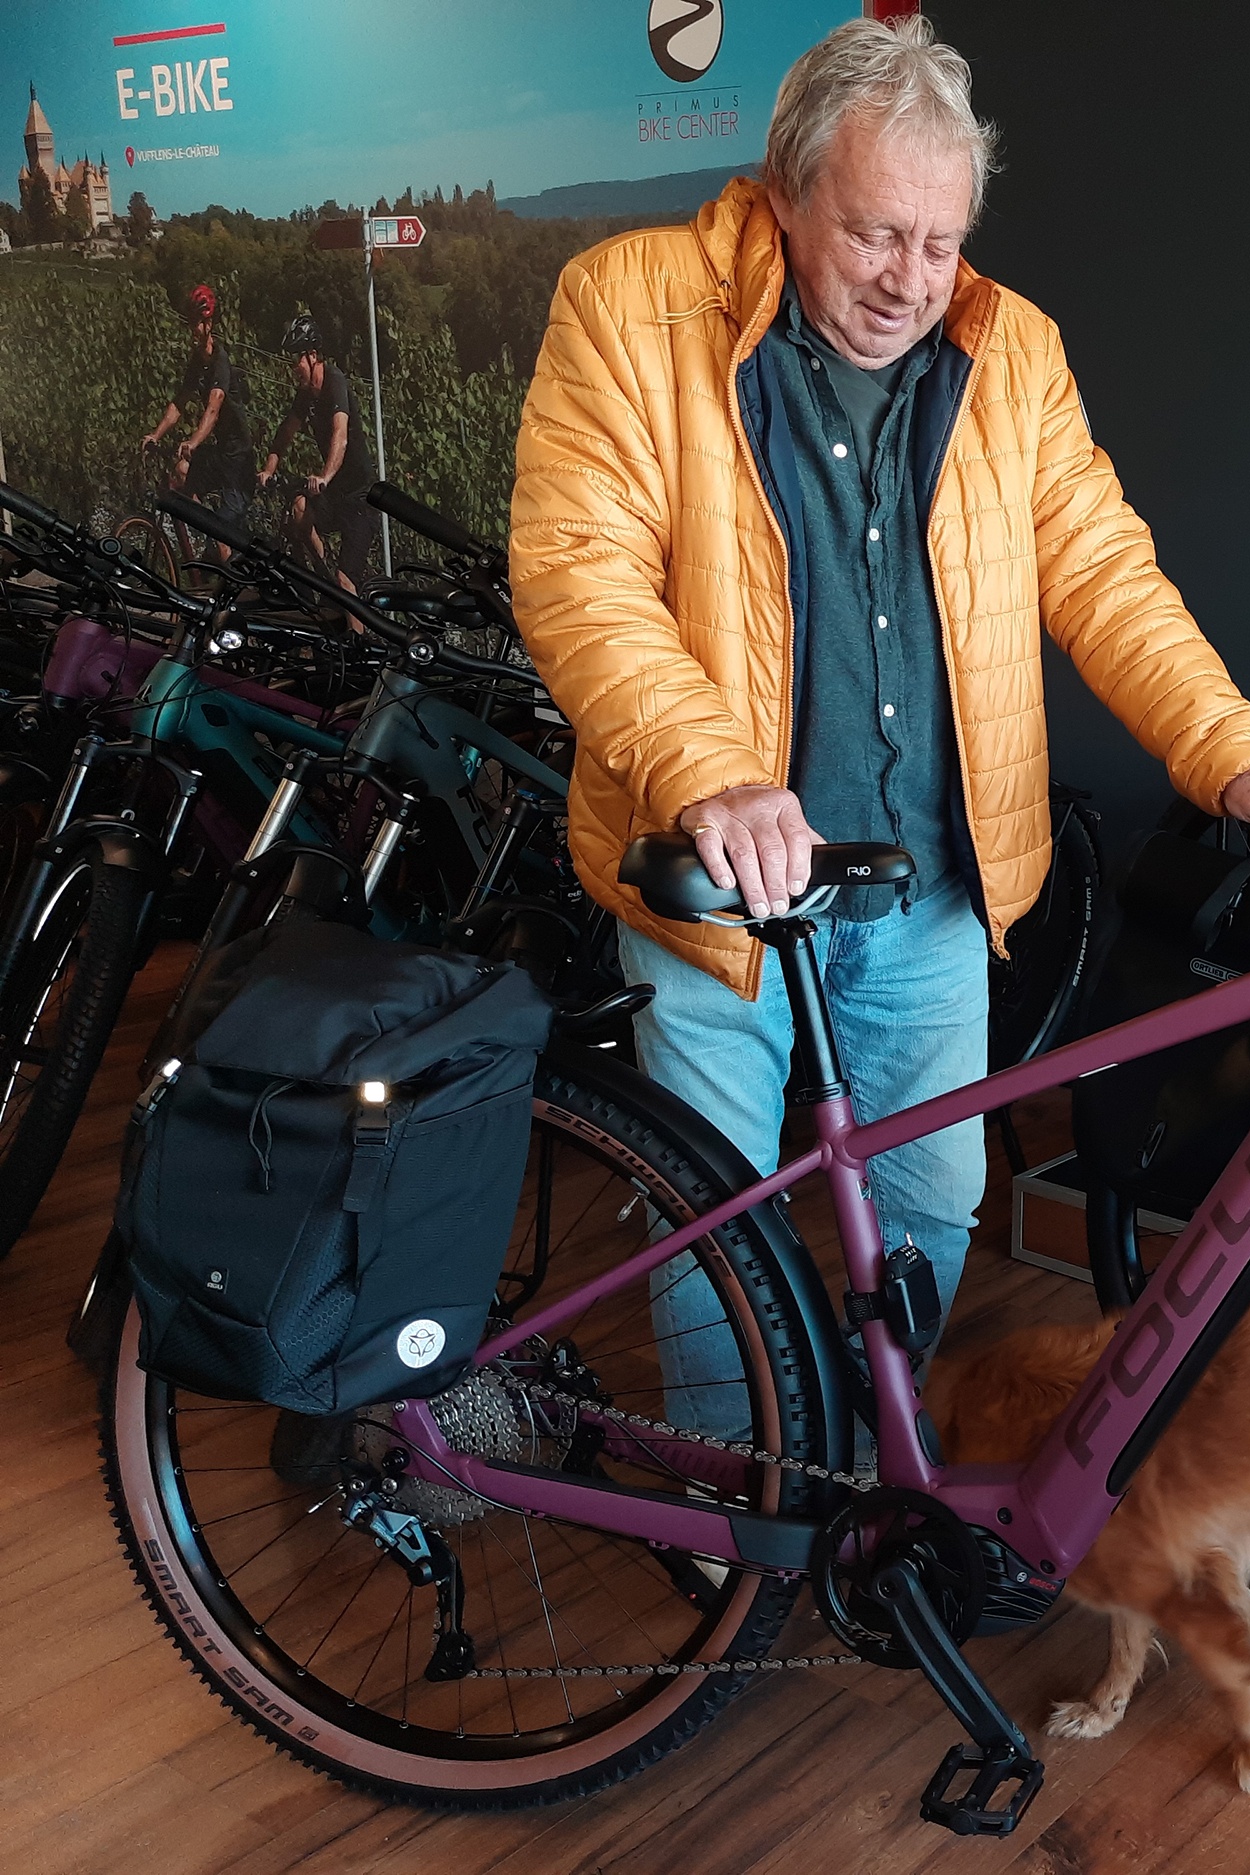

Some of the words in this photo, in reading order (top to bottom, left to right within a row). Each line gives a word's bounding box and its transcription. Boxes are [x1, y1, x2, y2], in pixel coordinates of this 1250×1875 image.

[116, 57, 233, 120] E-BIKE
[638, 94, 740, 116] PRIMUS
[639, 116, 671, 141] BIKE
[677, 111, 739, 139] CENTER
[846, 865, 871, 877] RIO
[1193, 961, 1225, 978] ORTLIEB
[144, 1539, 223, 1655] SMART
[223, 1666, 295, 1726] SAM
